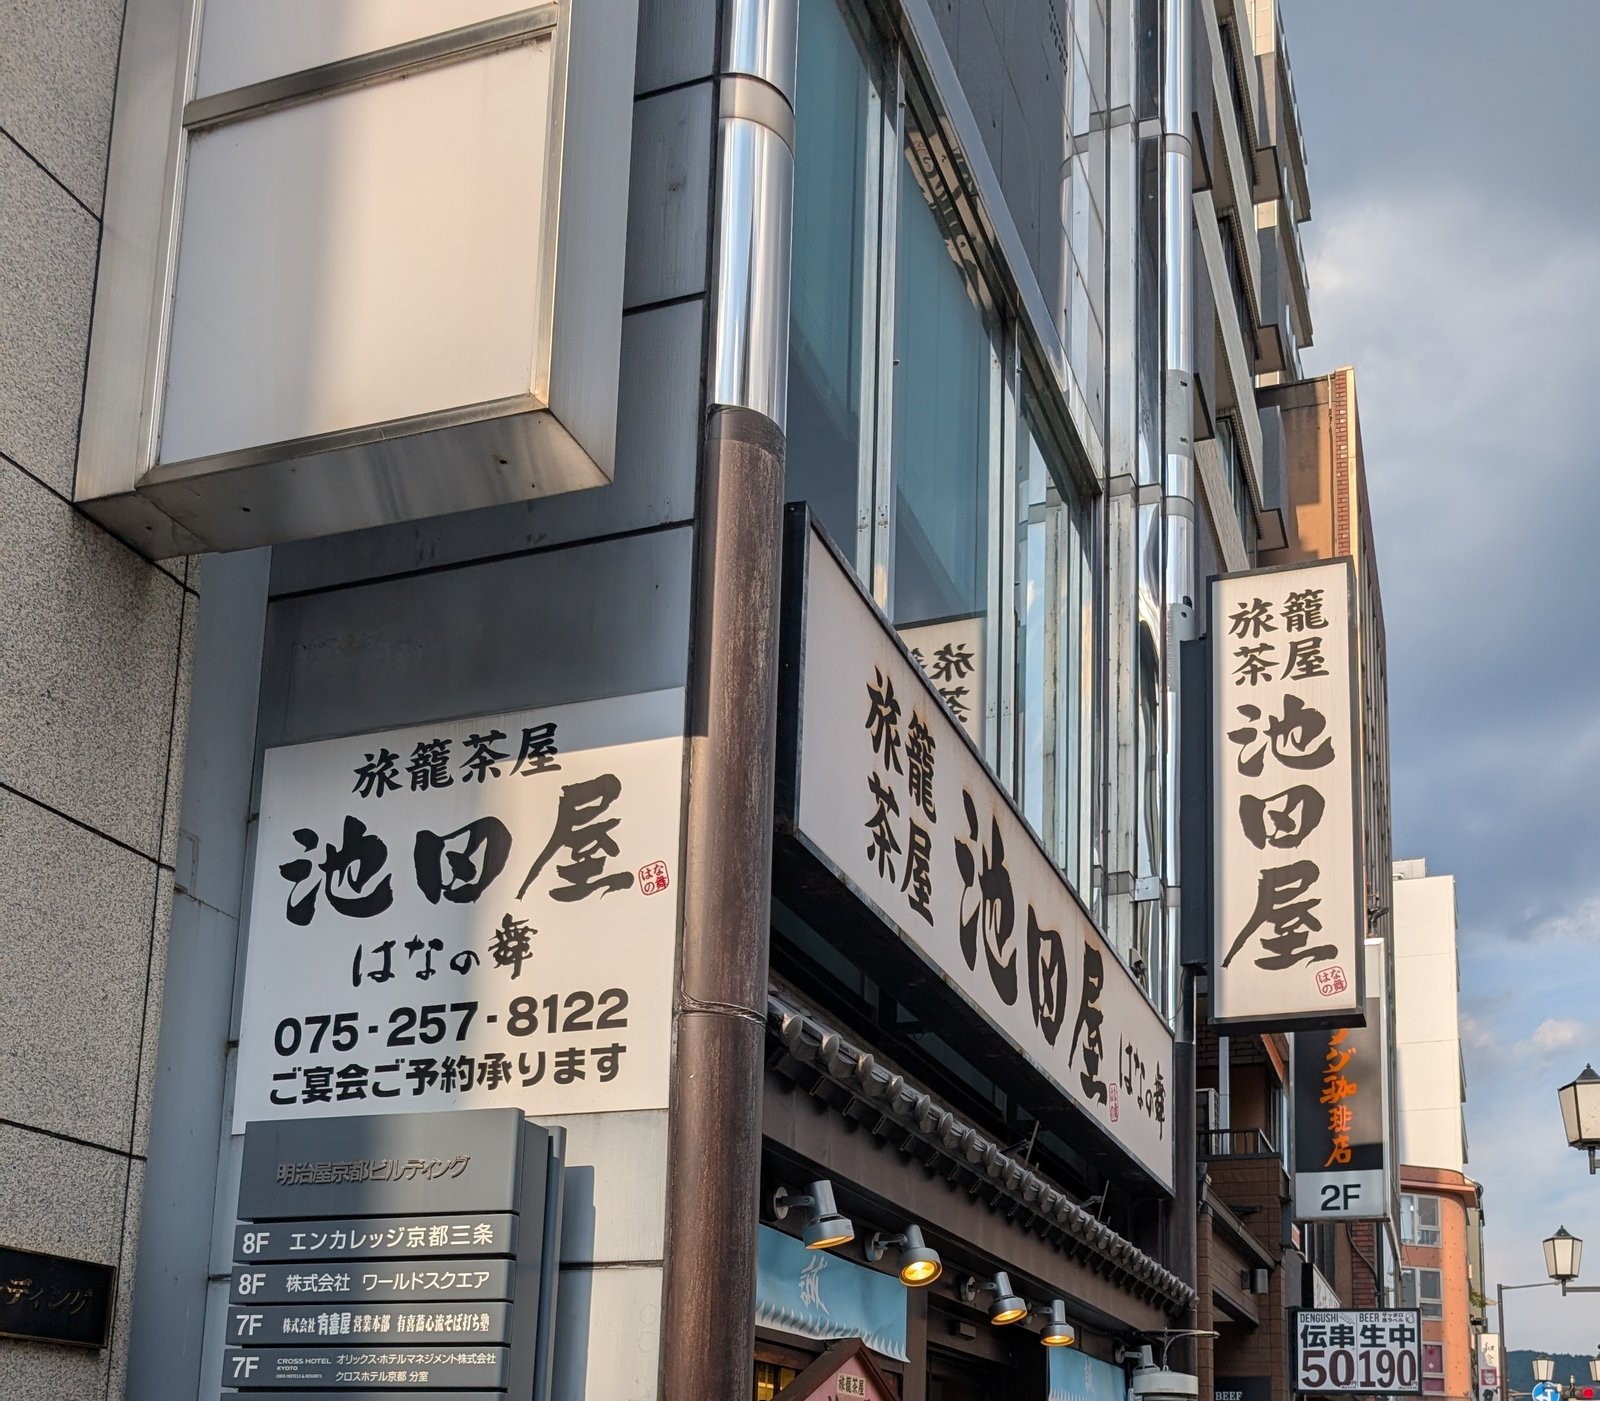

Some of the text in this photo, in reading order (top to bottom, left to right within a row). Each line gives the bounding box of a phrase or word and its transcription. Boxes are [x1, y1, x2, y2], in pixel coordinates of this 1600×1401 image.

[1228, 588, 1329, 640] 旅籠
[1231, 639, 1330, 687] 茶屋
[352, 721, 564, 799] 旅籠茶屋
[864, 665, 938, 824] 旅籠
[279, 773, 635, 927] 池田屋
[863, 770, 935, 927] 茶屋
[1221, 693, 1338, 971] 池田屋
[353, 912, 539, 987] はなの舞
[954, 788, 1108, 1107] 池田屋
[274, 987, 630, 1057] 075-257-8122
[269, 1042, 628, 1106] ご宴会ご予約承ります
[1119, 1032, 1167, 1141] はなの舞
[276, 1154, 472, 1187] 明治屋京都ビルディング
[1320, 1183, 1362, 1212] 2F
[242, 1222, 494, 1255] 8F エンカレッジ京都三条
[238, 1270, 491, 1295] 8F 株式会社 ワールドスクエア
[236, 1314, 264, 1336] 7F
[1300, 1312, 1339, 1323] DENGUSHI
[1300, 1323, 1355, 1349] 伝串
[1359, 1312, 1380, 1323] BEER
[1359, 1323, 1415, 1349] 生中
[232, 1356, 260, 1378] 7F
[277, 1357, 332, 1365] CROSS HOTEL
[335, 1370, 429, 1382] クロスホテル京都 分室
[1301, 1349, 1355, 1388] 50
[1358, 1349, 1417, 1388] 190
[1215, 1391, 1243, 1401] BEEF
